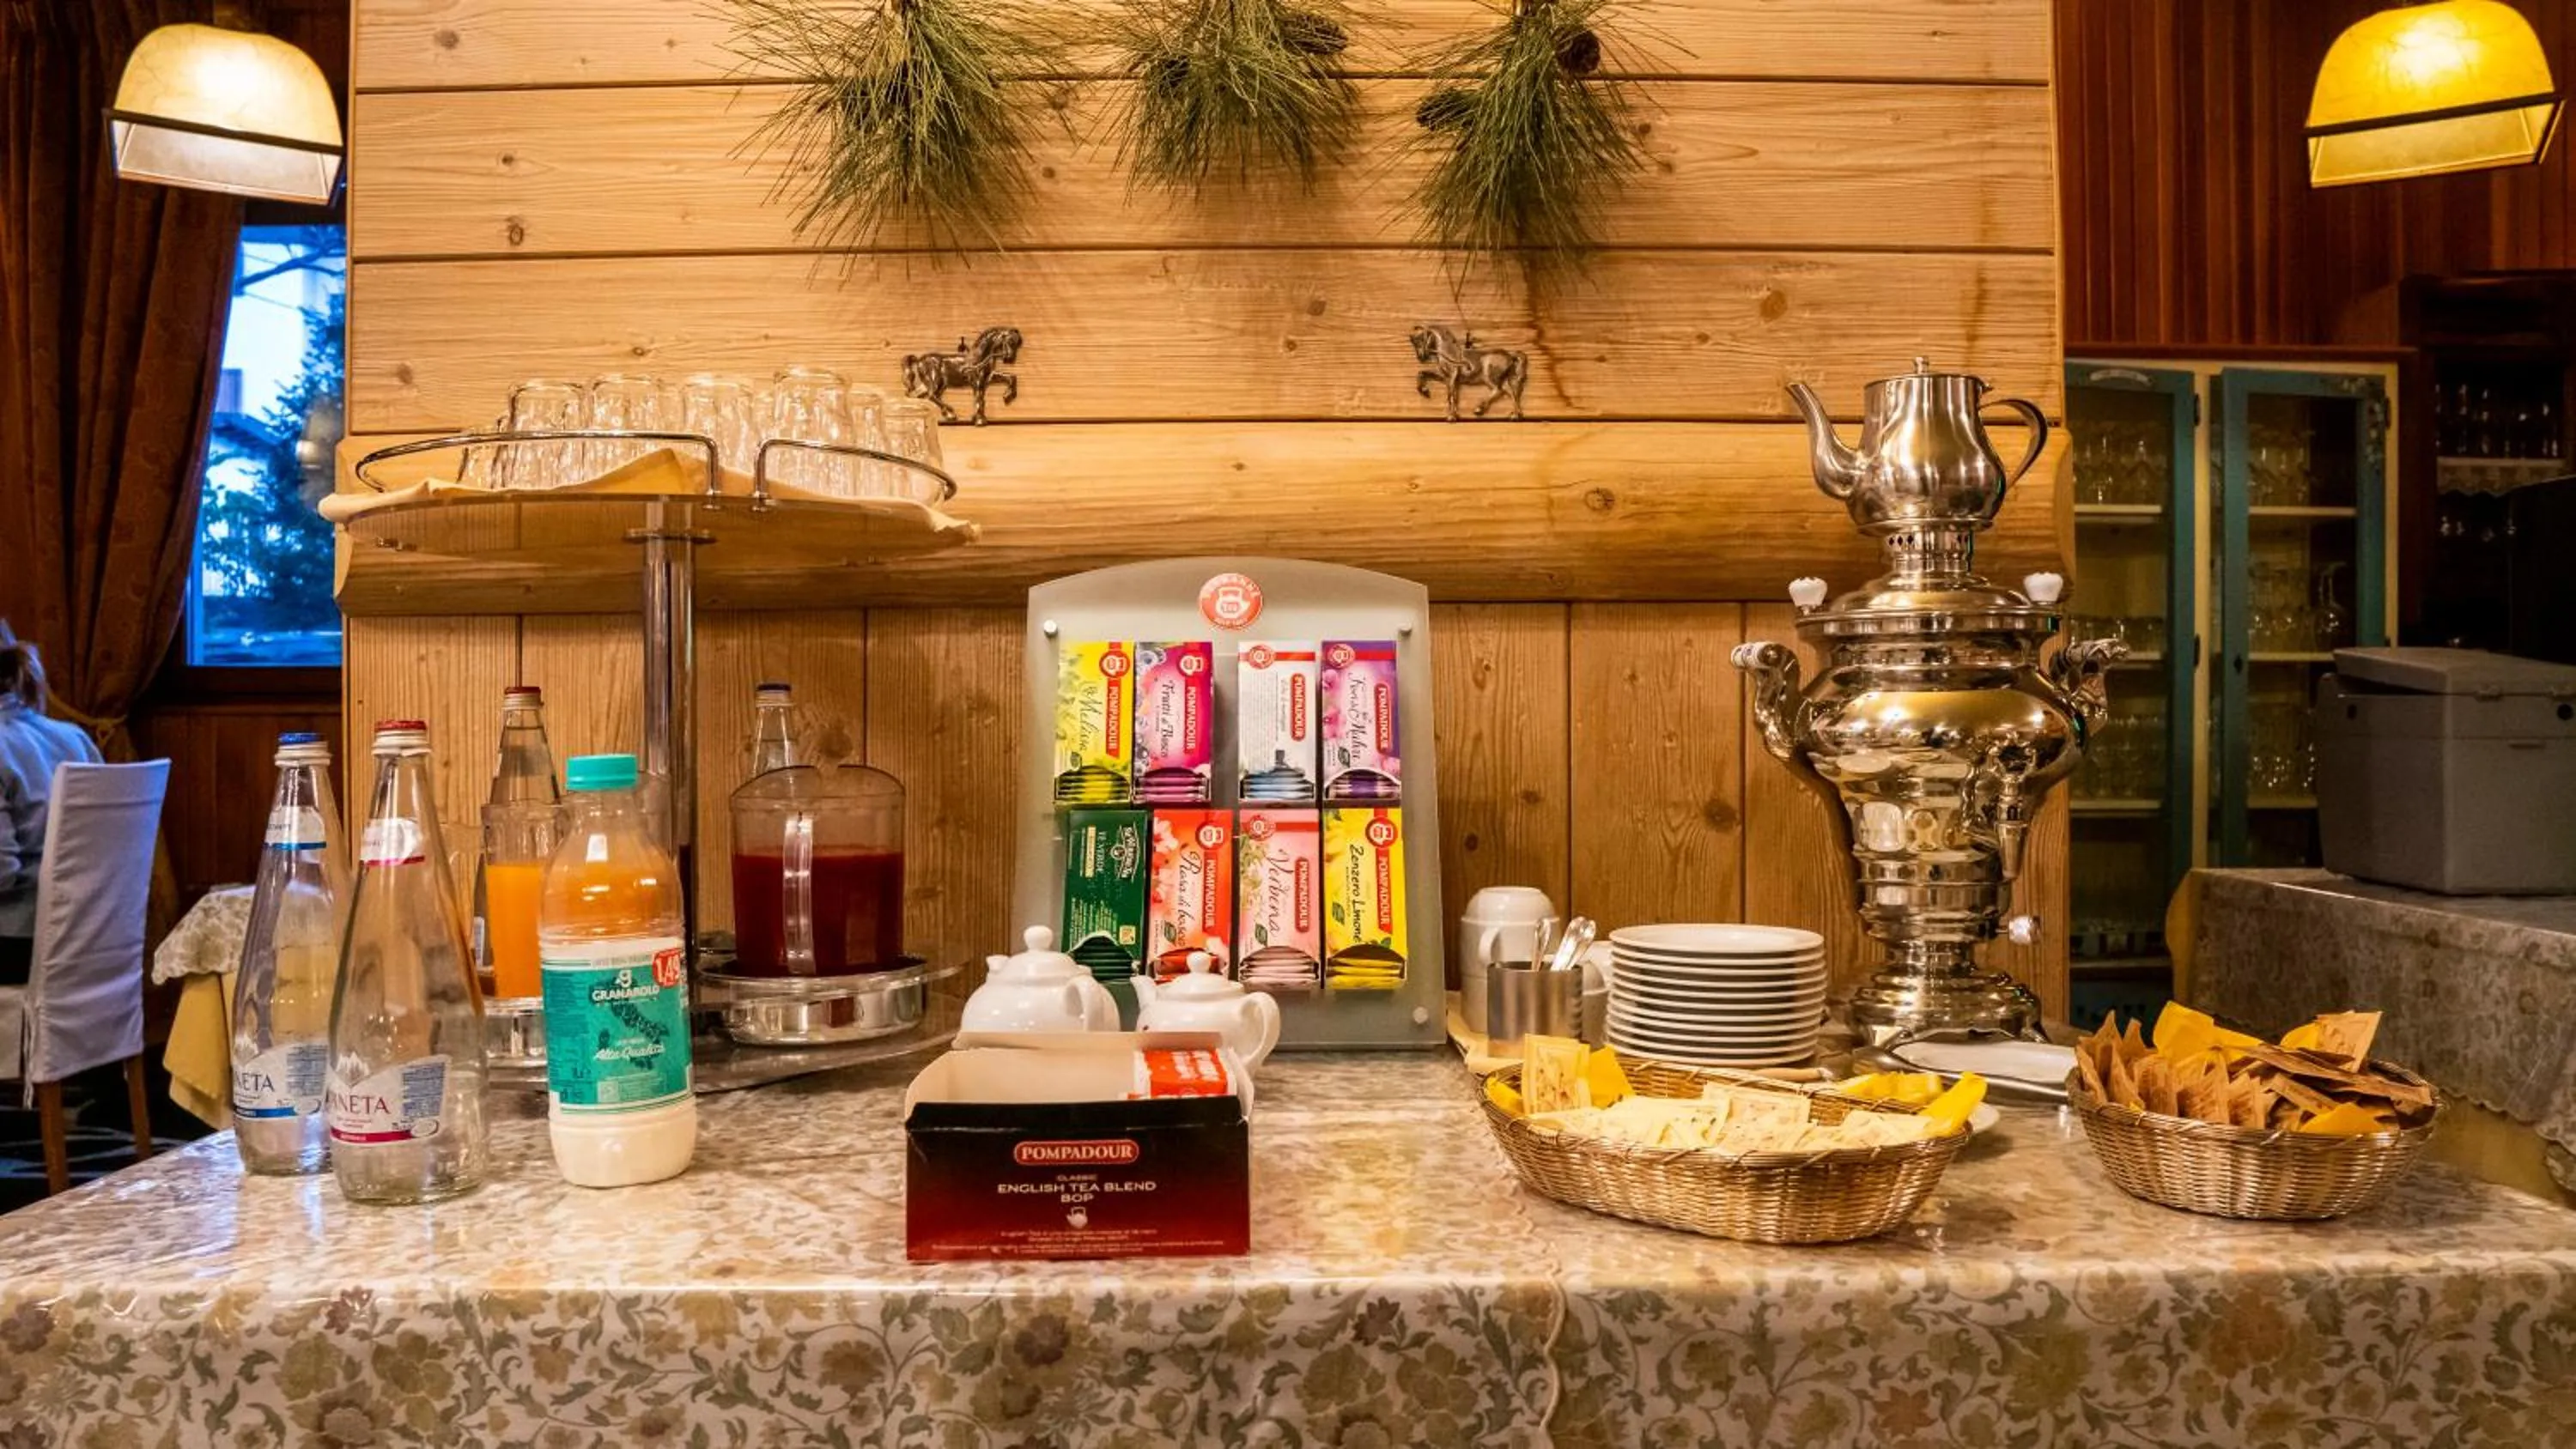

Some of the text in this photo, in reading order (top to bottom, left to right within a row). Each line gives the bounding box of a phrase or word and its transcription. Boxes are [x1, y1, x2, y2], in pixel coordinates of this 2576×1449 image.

[1108, 686, 1119, 750] POMPADOUR
[1186, 686, 1196, 750] POMPADOUR
[1294, 673, 1303, 738] POMPADOUR
[1378, 687, 1390, 749] POMPADOUR
[1205, 859, 1217, 928] POMPADOUR
[1267, 848, 1294, 937] Verbena
[1299, 861, 1309, 927] POMPADOUR
[1350, 844, 1367, 943] Zenzero Limone
[1378, 857, 1391, 925] POMPADOUR
[592, 985, 660, 1003] GRANAROLO
[1020, 1144, 1133, 1161] POMPADOUR
[997, 1180, 1157, 1194] ENGLISH TEA BLEND
[1060, 1193, 1094, 1203] BOP
